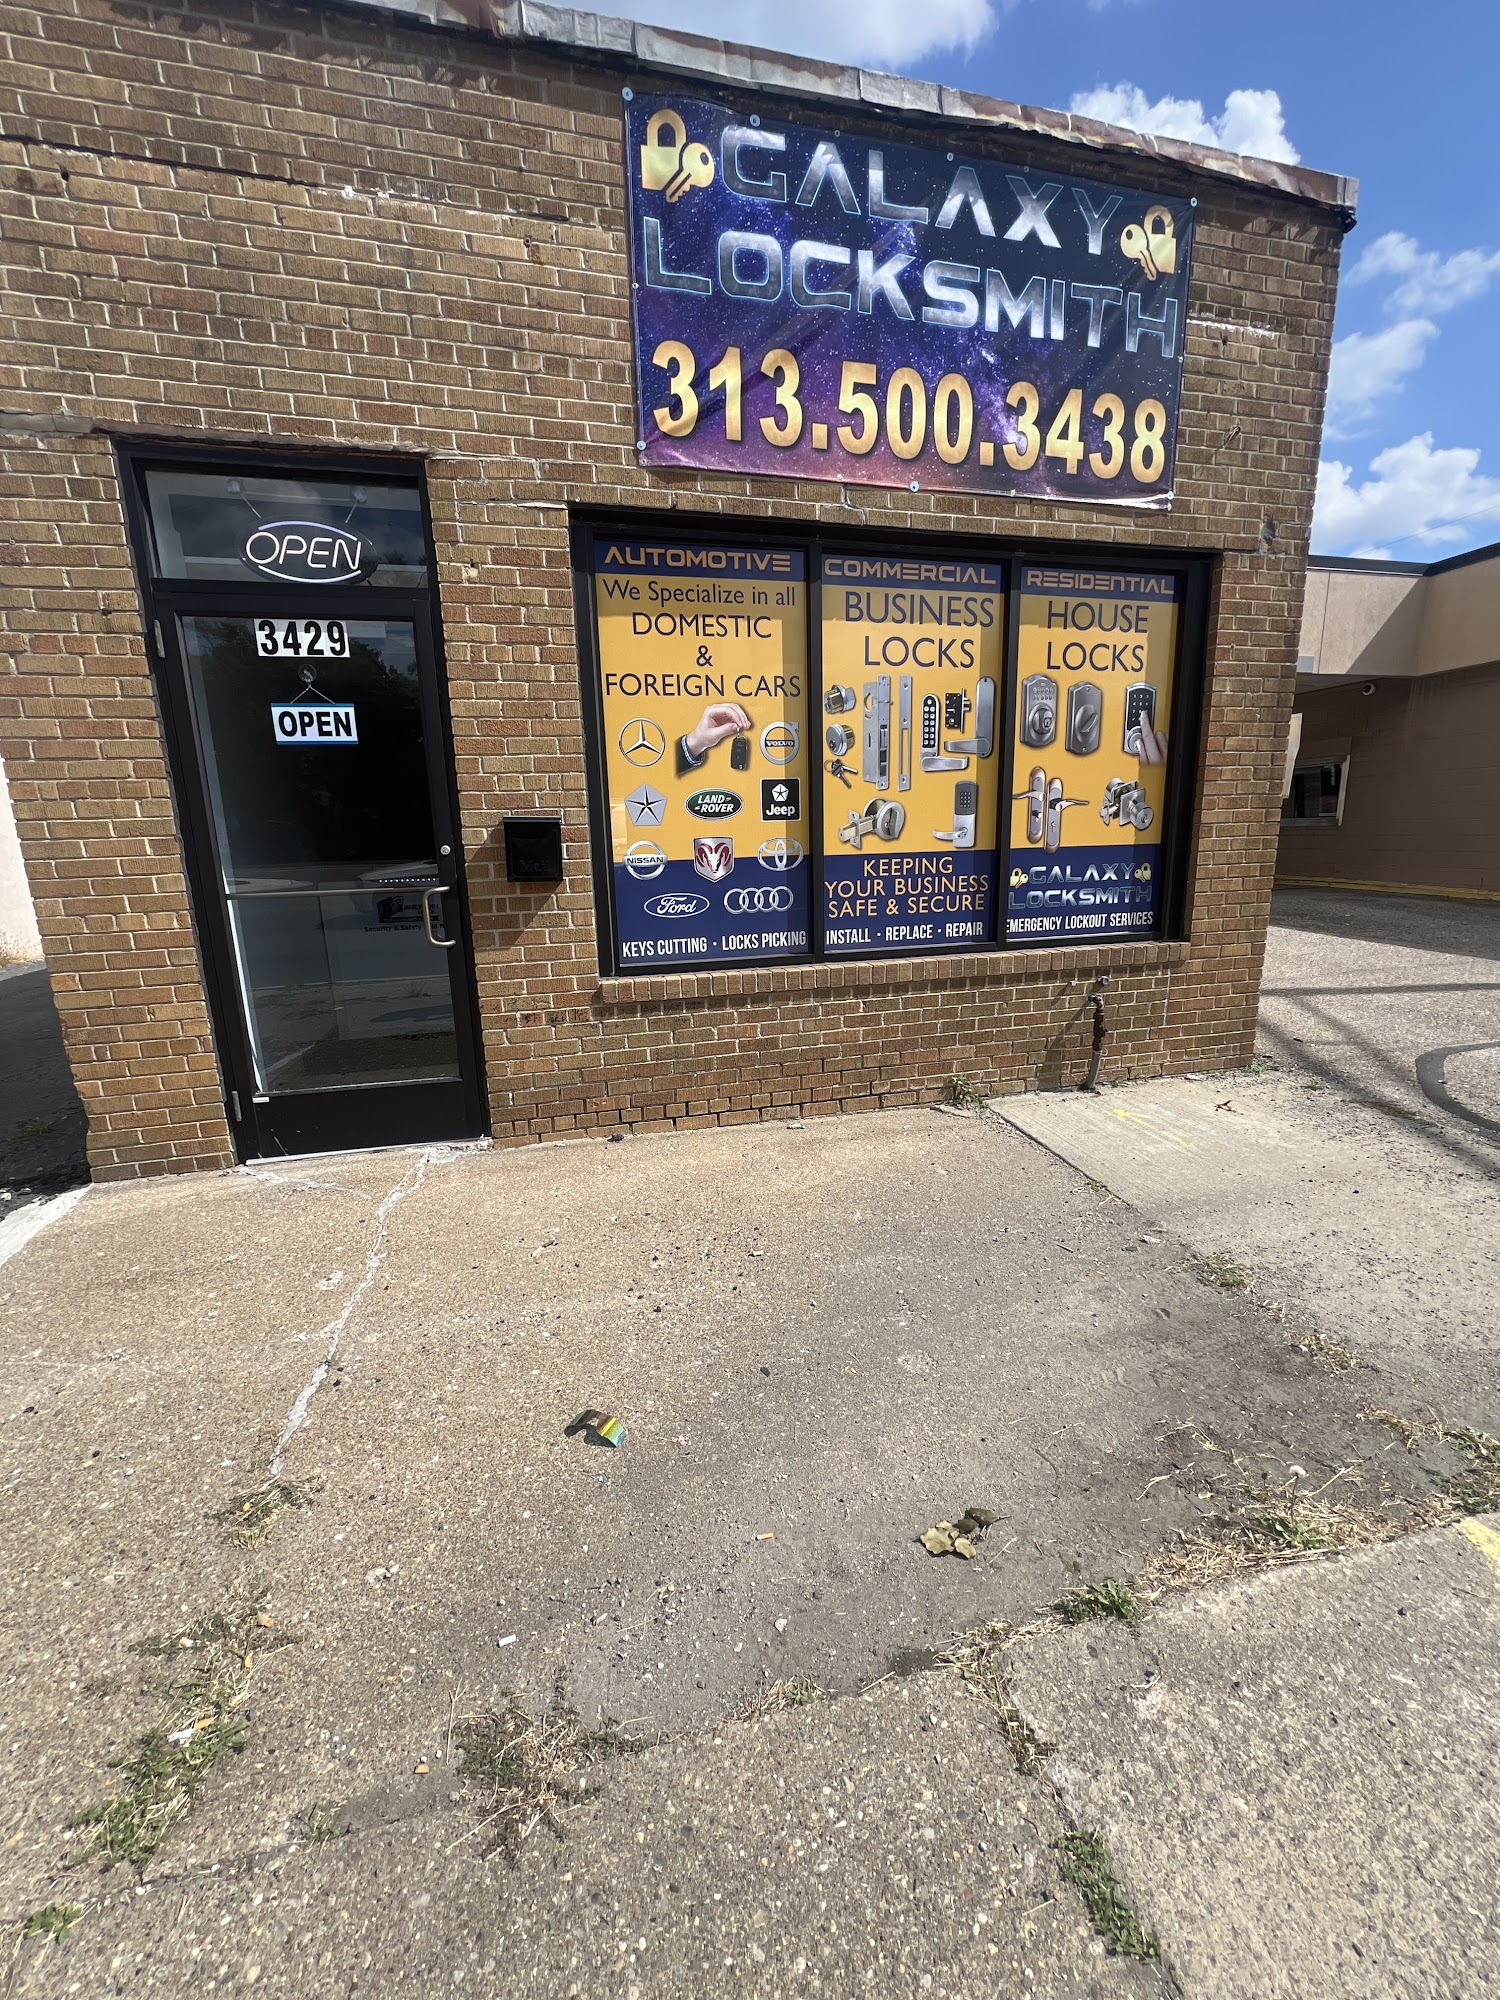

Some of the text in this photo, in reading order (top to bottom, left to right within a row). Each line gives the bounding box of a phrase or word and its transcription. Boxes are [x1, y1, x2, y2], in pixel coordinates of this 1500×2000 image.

[720, 125, 1123, 255] GALAXY
[643, 216, 1177, 358] LOCKSMITH
[652, 340, 1166, 484] 313.500.3438
[246, 531, 361, 571] OPEN
[605, 546, 791, 572] AUTOMOTIVE
[824, 559, 997, 585] COMMERCIAL
[1027, 570, 1174, 595] RESIDENTIAL
[602, 579, 795, 607] We Specialize in all
[845, 591, 994, 628] BUSINESS
[1047, 600, 1149, 634] HOUSE
[258, 619, 347, 656] 3429
[632, 612, 772, 638] DOMESTIC
[696, 645, 713, 667] &
[864, 635, 975, 669] LOCKS
[1046, 641, 1145, 673] LOCKS
[605, 673, 801, 698] FOREIGN CARS
[278, 711, 352, 737] OPEN
[765, 804, 796, 817] Jeep
[626, 856, 664, 864] NISSAN
[863, 856, 953, 877] KEEPING
[824, 874, 989, 899] YOUR BUSINESS
[1029, 862, 1136, 885] GALAXY
[656, 896, 697, 915] Ford
[828, 894, 985, 919] SAFE & SECURE
[1008, 886, 1153, 910] LOCKSMITH
[826, 921, 983, 945] INSTALL REPLACE REPAIR
[1065, 914, 1107, 930] LOCKOUT
[1109, 911, 1153, 927] SERVICES
[622, 930, 806, 958] KEYS CUTTING LOCKS PICKING
